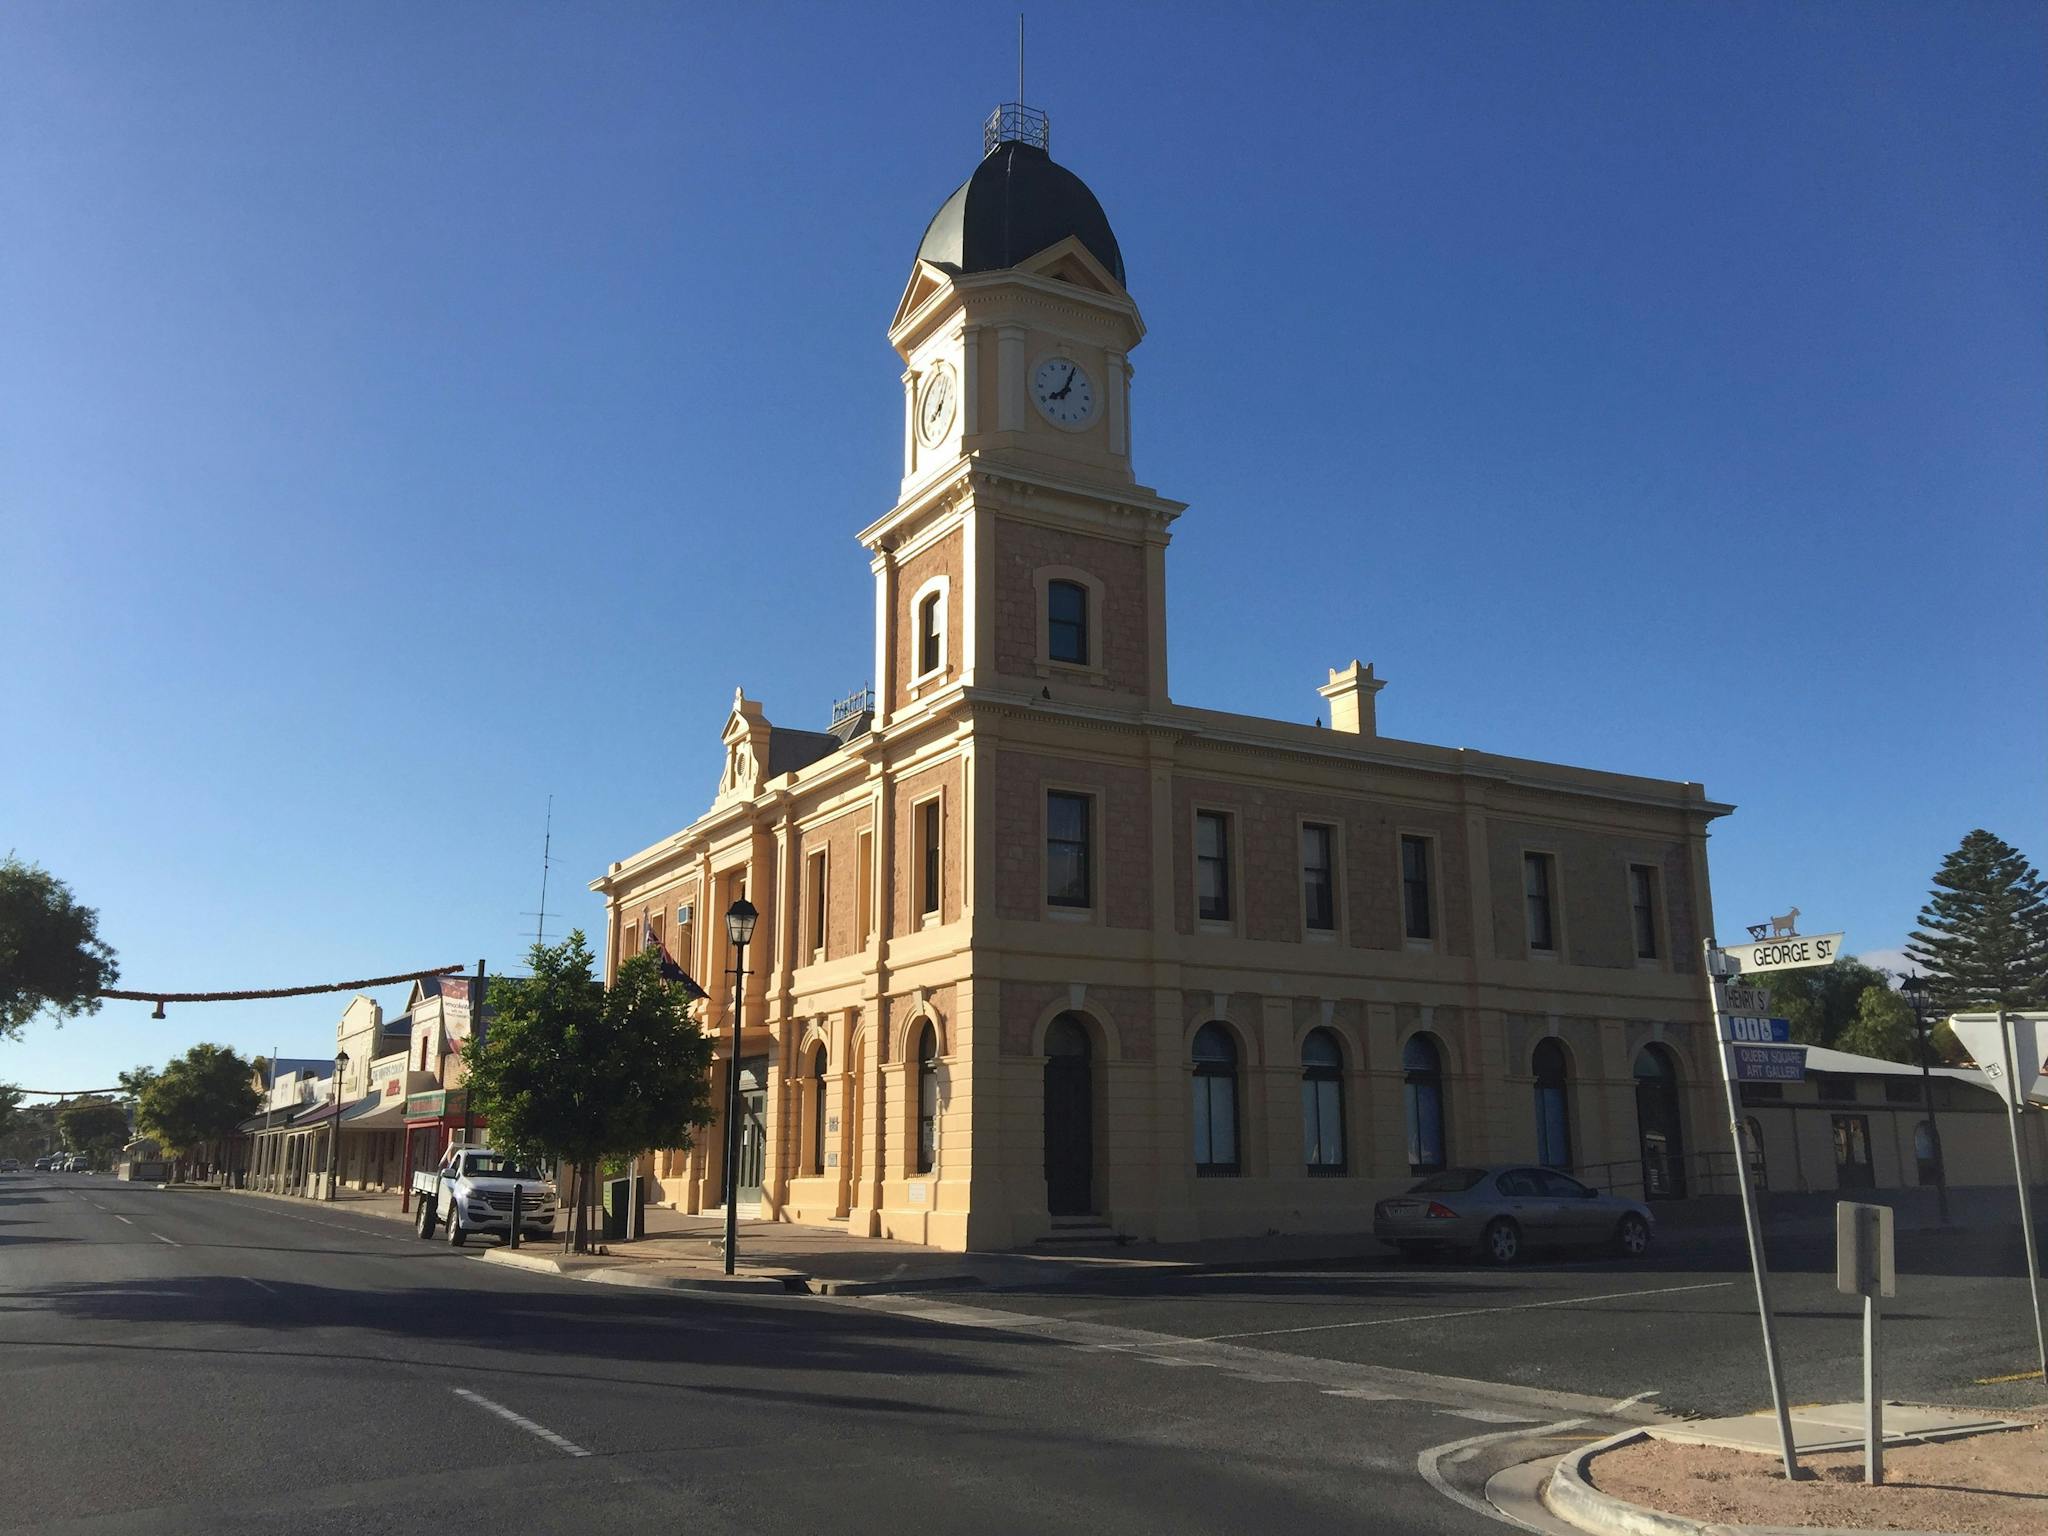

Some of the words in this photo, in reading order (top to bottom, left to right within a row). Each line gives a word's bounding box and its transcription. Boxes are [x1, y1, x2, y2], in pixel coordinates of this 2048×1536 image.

[1753, 943, 1811, 967] GEORGE
[1728, 990, 1754, 1009] HENRY
[1741, 1048, 1768, 1062] QUEEN
[1771, 1050, 1802, 1064] SQUARE
[1746, 1064, 1762, 1078] ART
[1765, 1065, 1800, 1079] GALLERY
